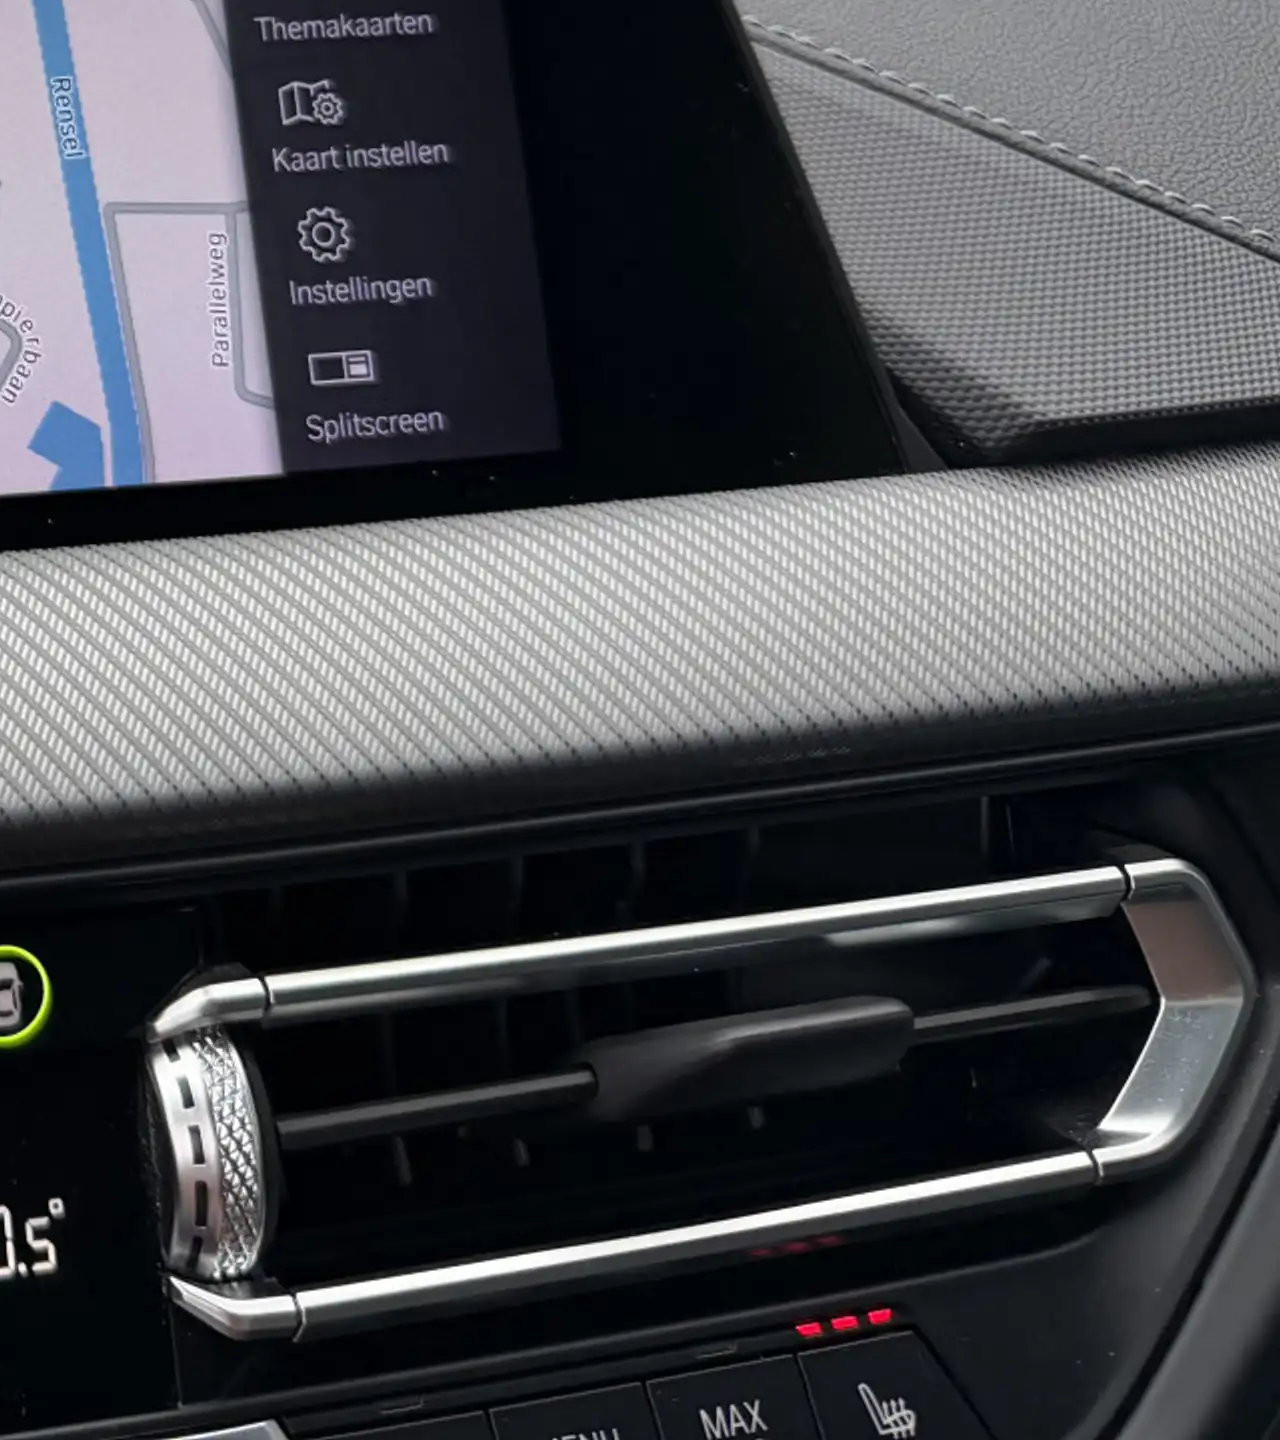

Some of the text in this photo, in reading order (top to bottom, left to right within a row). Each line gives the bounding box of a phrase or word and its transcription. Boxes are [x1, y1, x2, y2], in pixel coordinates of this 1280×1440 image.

[253, 12, 433, 42] Themakaarten
[52, 78, 84, 157] Rensel
[272, 140, 449, 172] Kaart instellen
[208, 233, 229, 367] Parallelweg
[289, 276, 433, 305] Instellingen
[306, 411, 445, 444] Splitscreen
[698, 1399, 769, 1440] MAX
